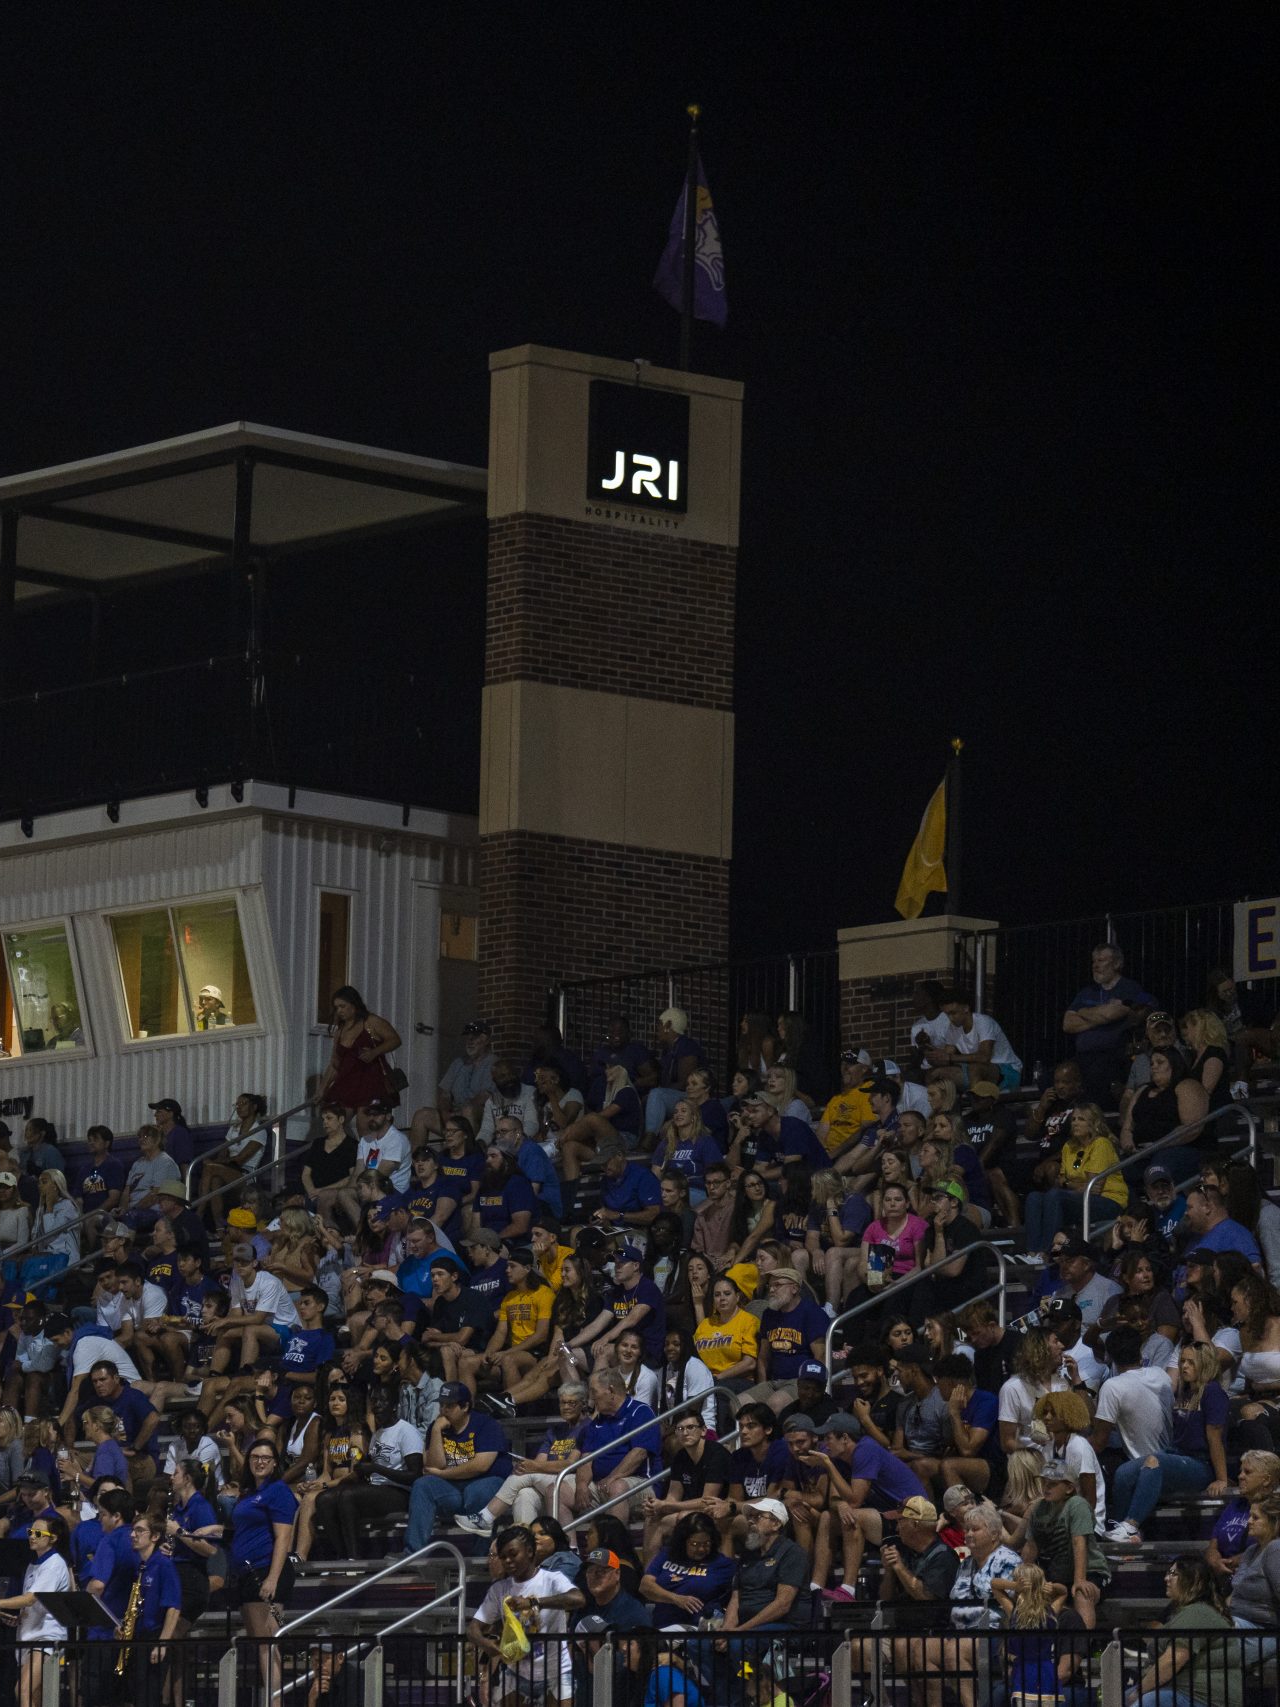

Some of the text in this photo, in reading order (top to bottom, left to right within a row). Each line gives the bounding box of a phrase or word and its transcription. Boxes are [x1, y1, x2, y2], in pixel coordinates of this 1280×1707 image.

[601, 450, 678, 501] JRI
[585, 506, 679, 529] HOSPITALITY
[1249, 906, 1276, 972] E
